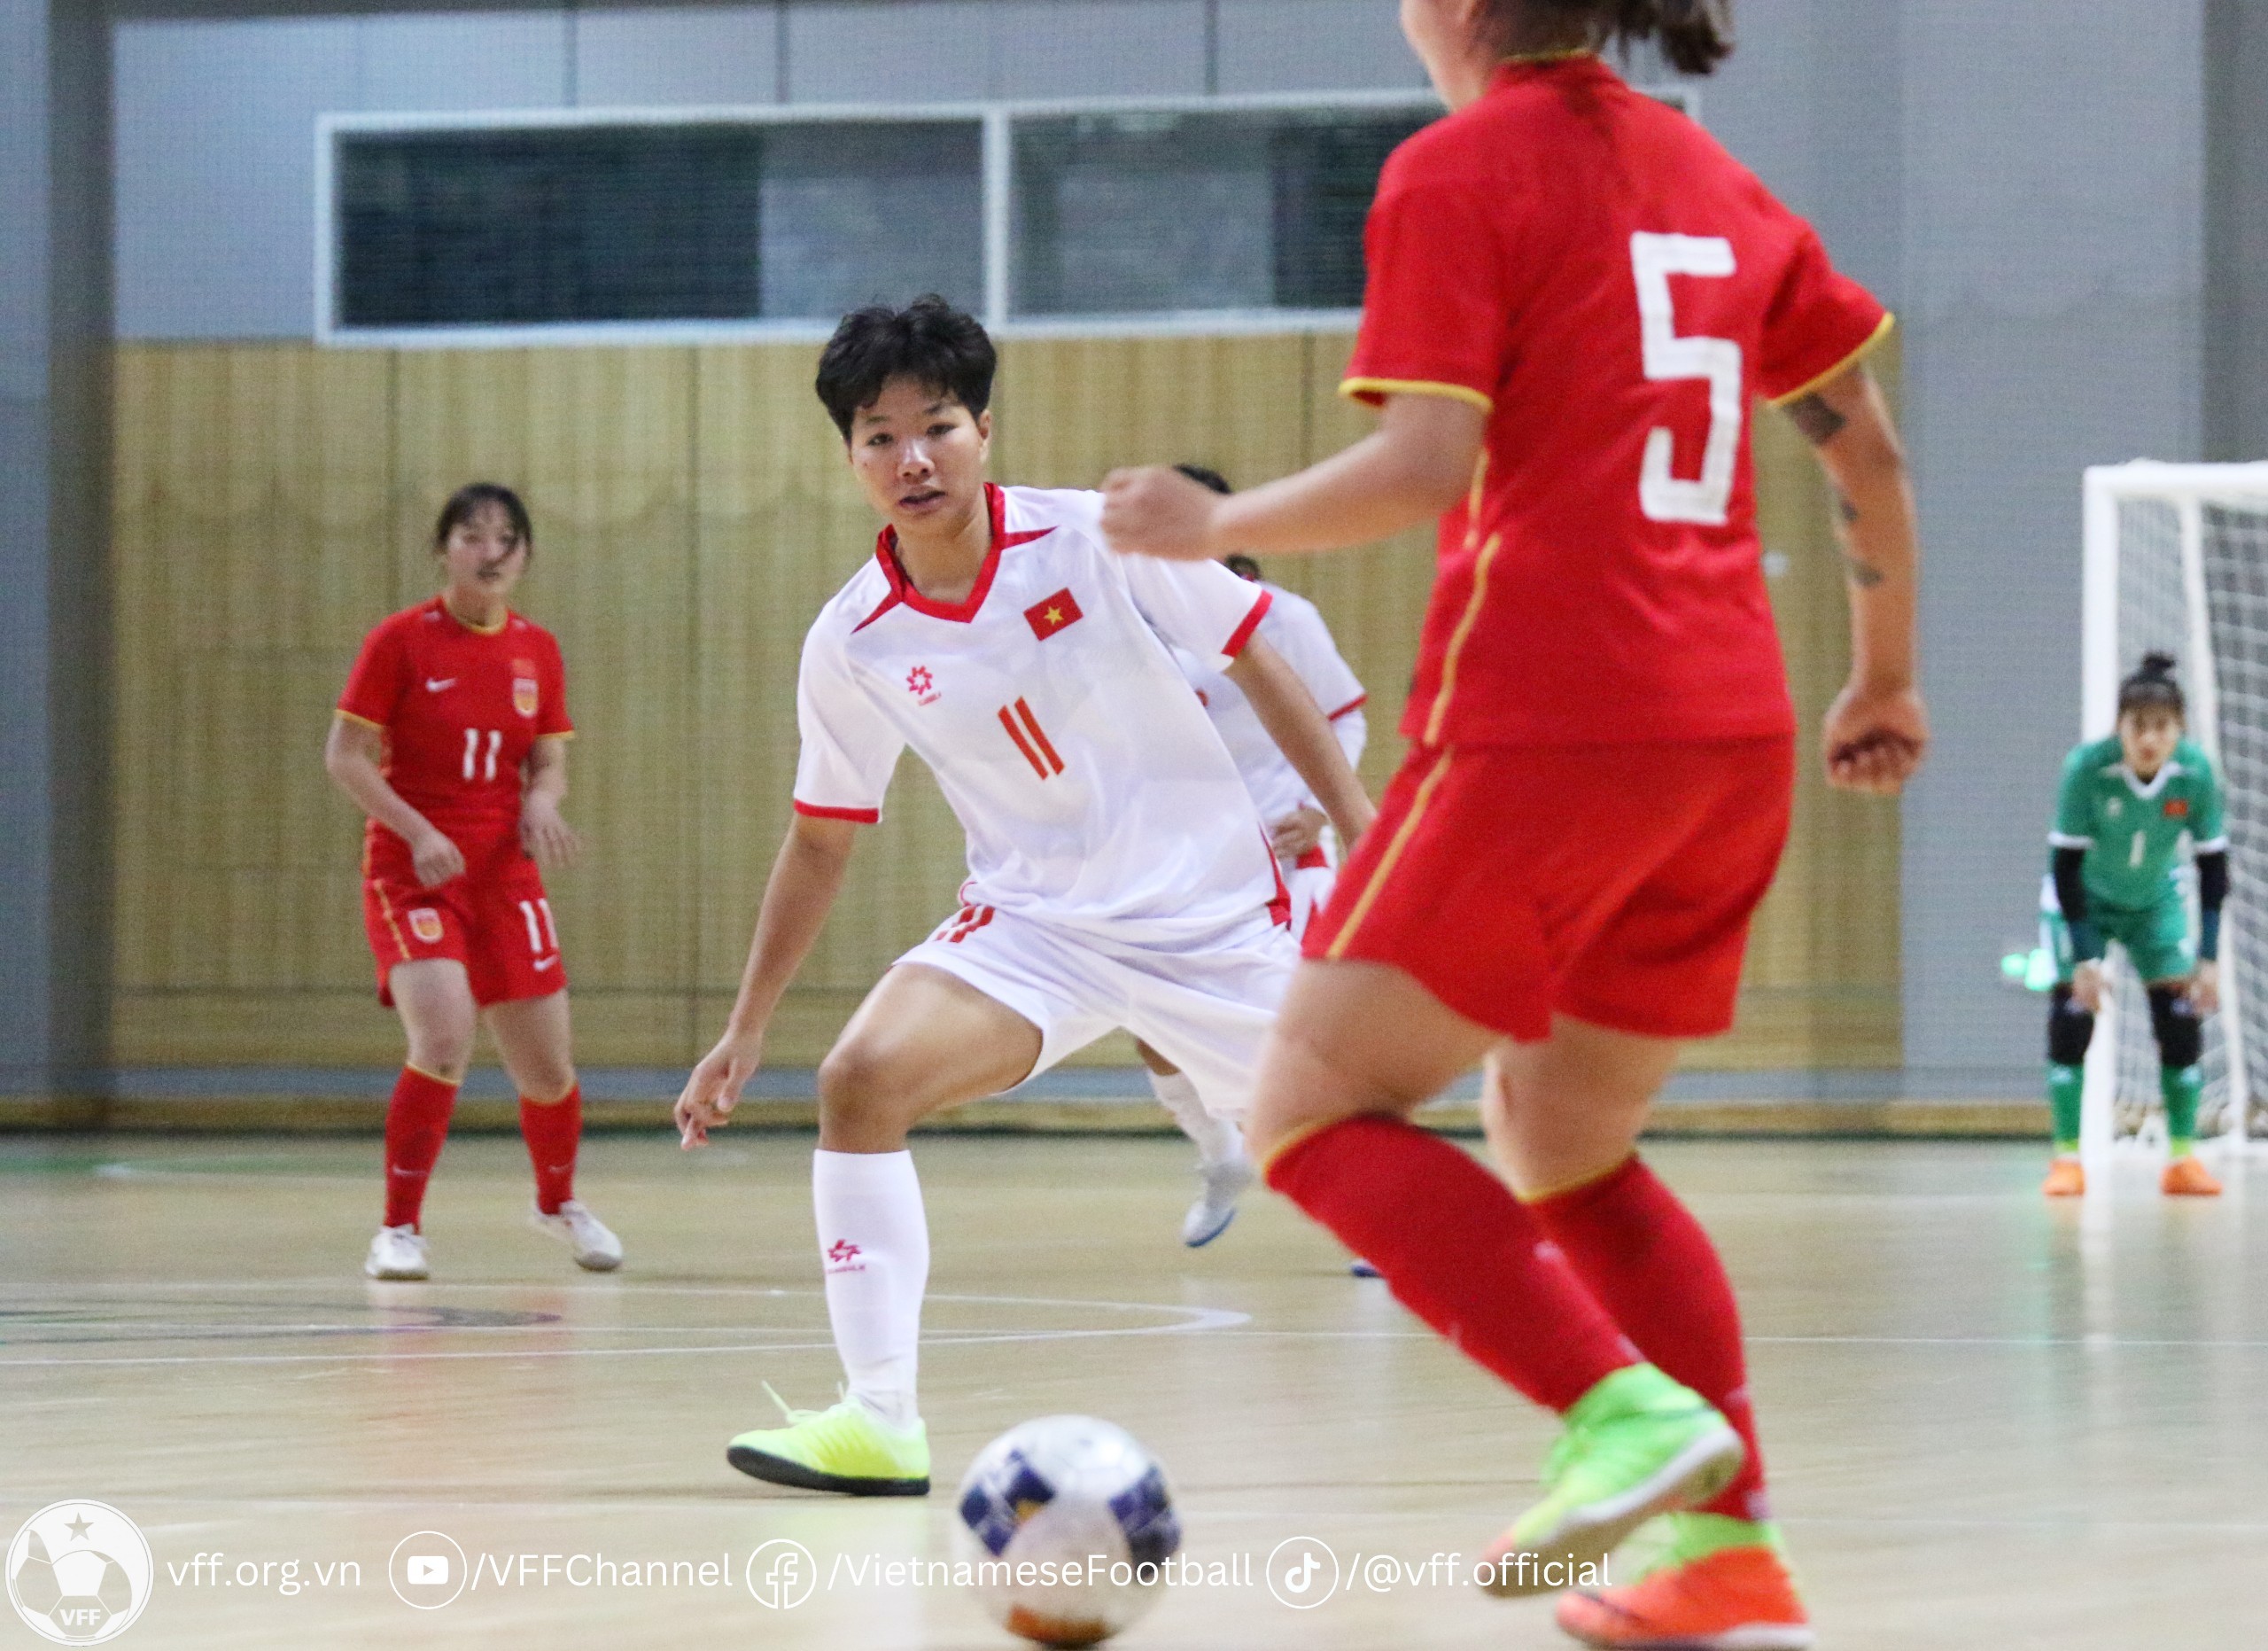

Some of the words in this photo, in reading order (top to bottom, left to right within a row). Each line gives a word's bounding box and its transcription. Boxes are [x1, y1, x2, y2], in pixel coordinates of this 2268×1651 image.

[1630, 230, 1743, 526] 5
[463, 728, 502, 781] 11
[998, 696, 1066, 780] 11
[2128, 829, 2147, 868] 1
[520, 897, 558, 954] 11
